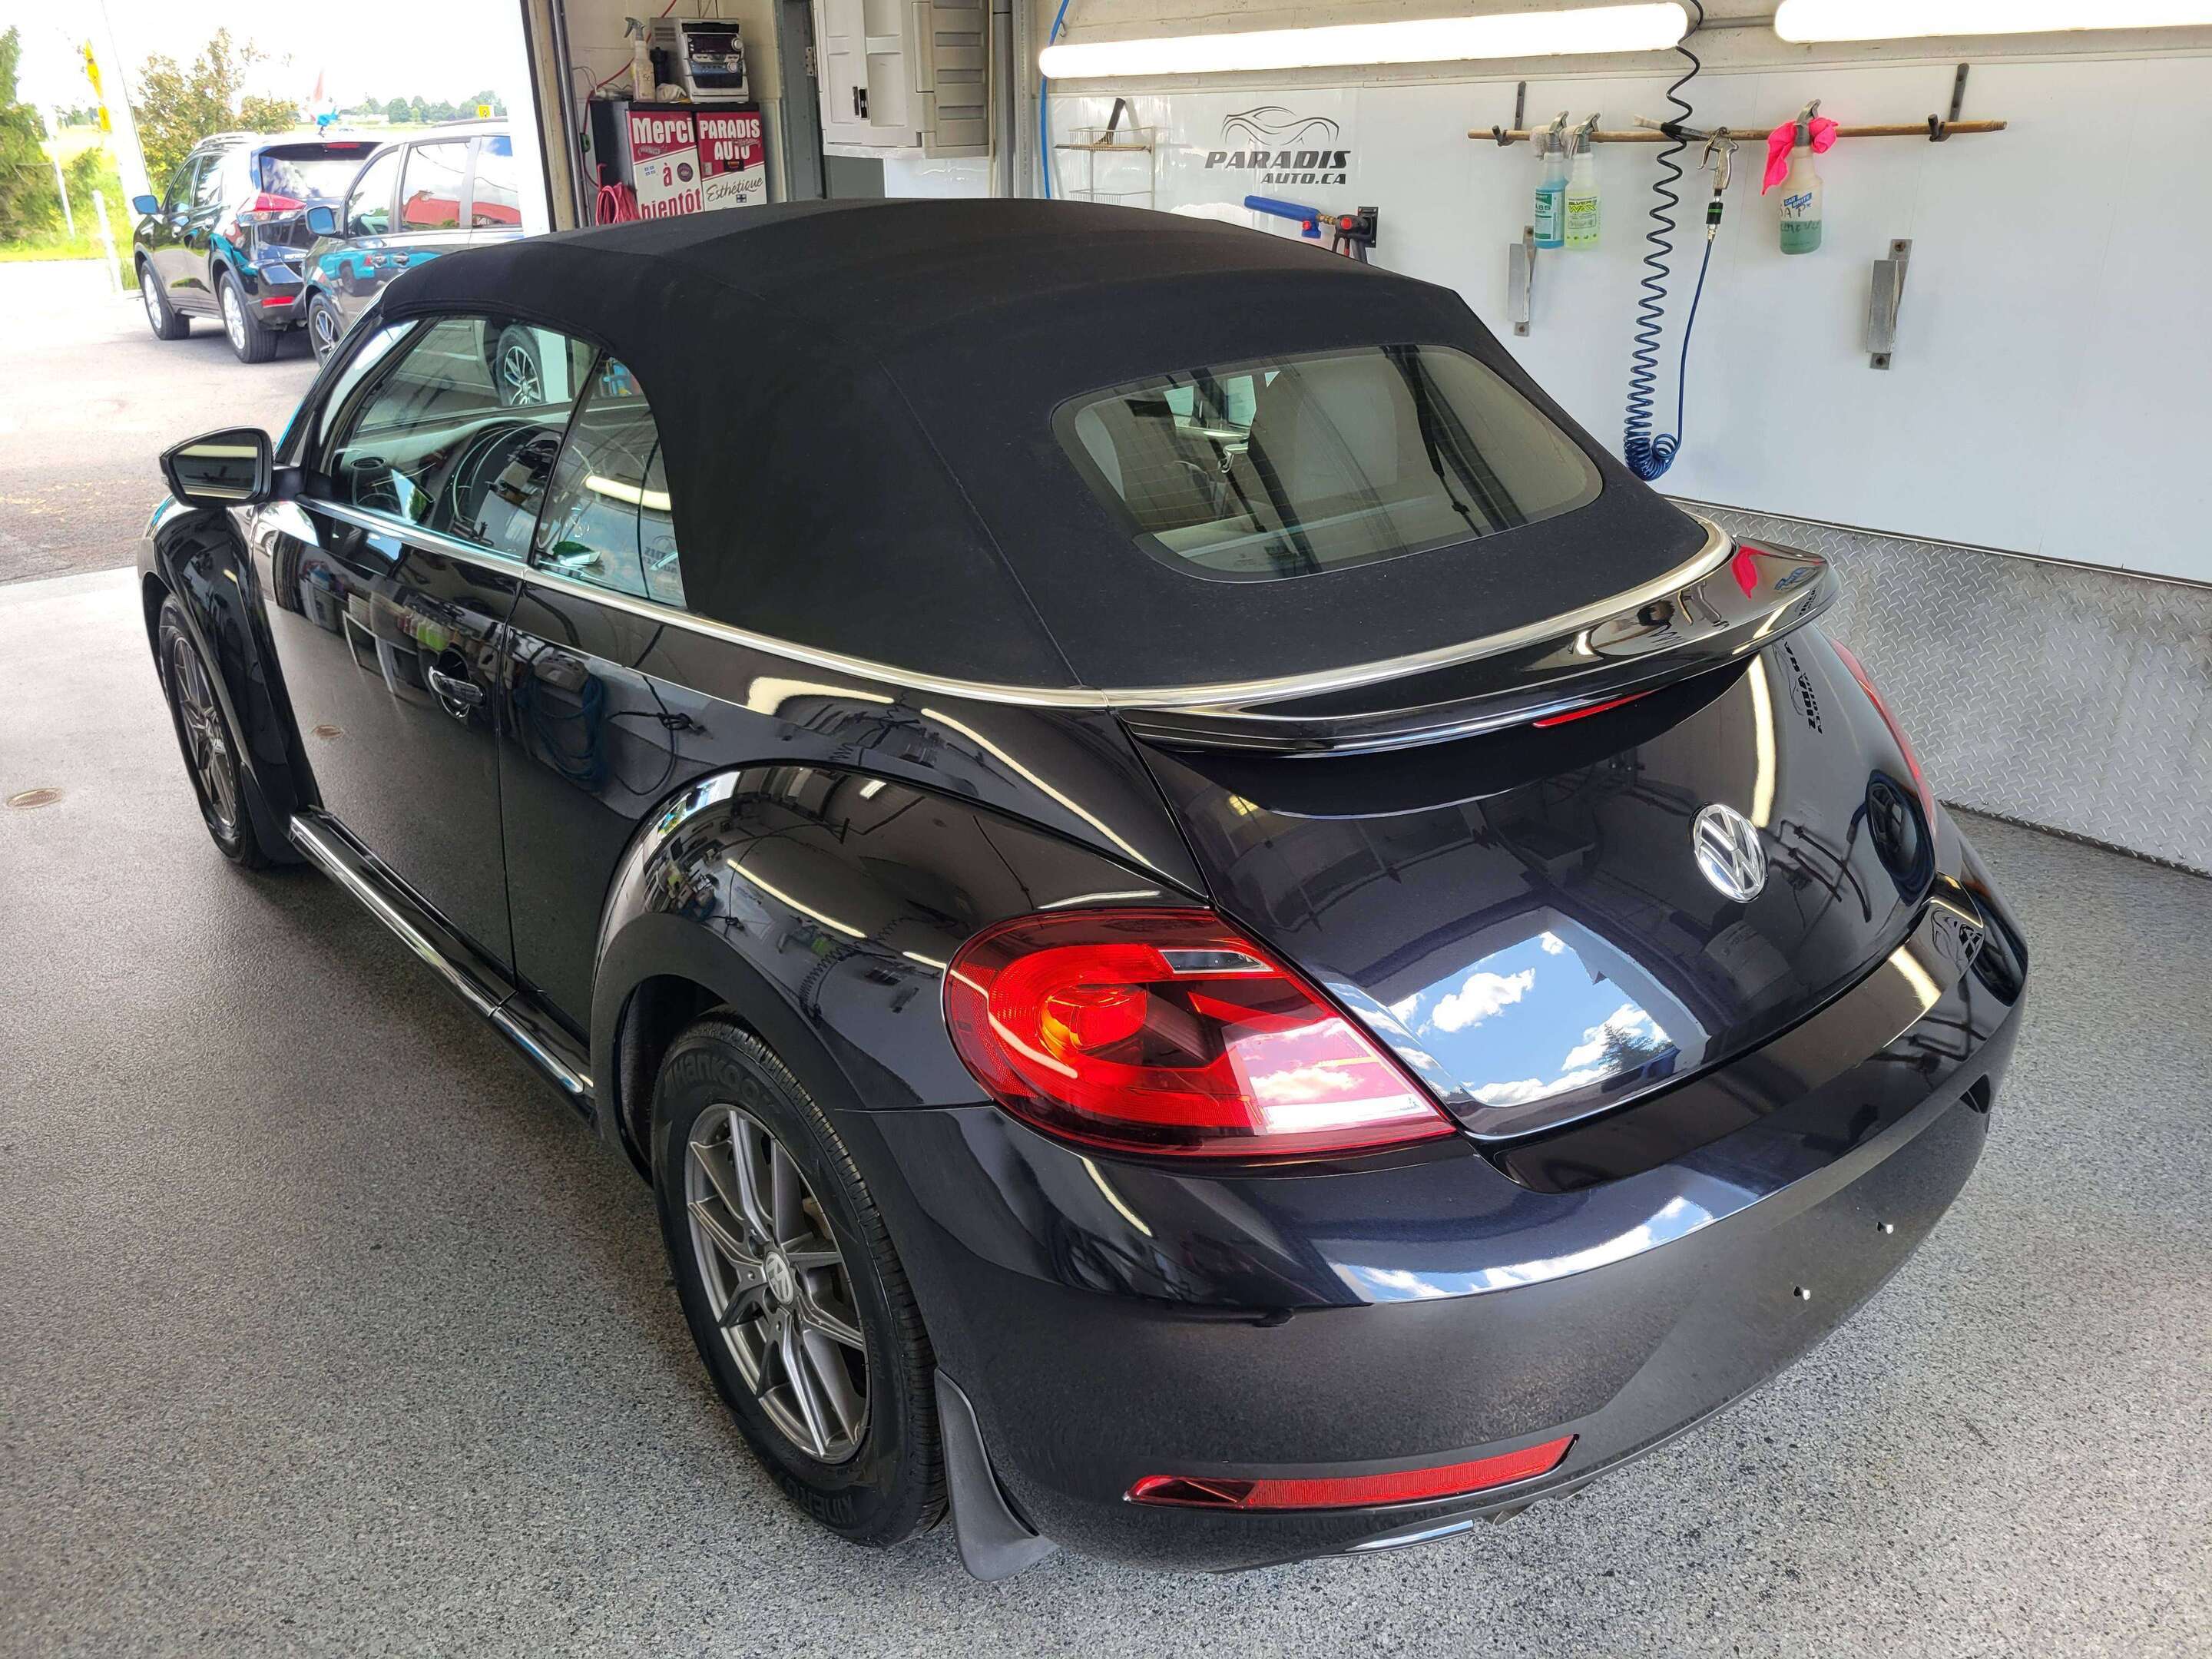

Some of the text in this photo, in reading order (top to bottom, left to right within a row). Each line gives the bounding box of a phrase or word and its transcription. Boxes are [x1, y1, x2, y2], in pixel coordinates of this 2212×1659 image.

[632, 118, 695, 144] Merci
[700, 118, 760, 139] PARADIS
[1204, 151, 1352, 169] PARADIS
[663, 162, 673, 187] à
[1260, 173, 1346, 185] AUTO.CA
[706, 177, 763, 203] Esthétique
